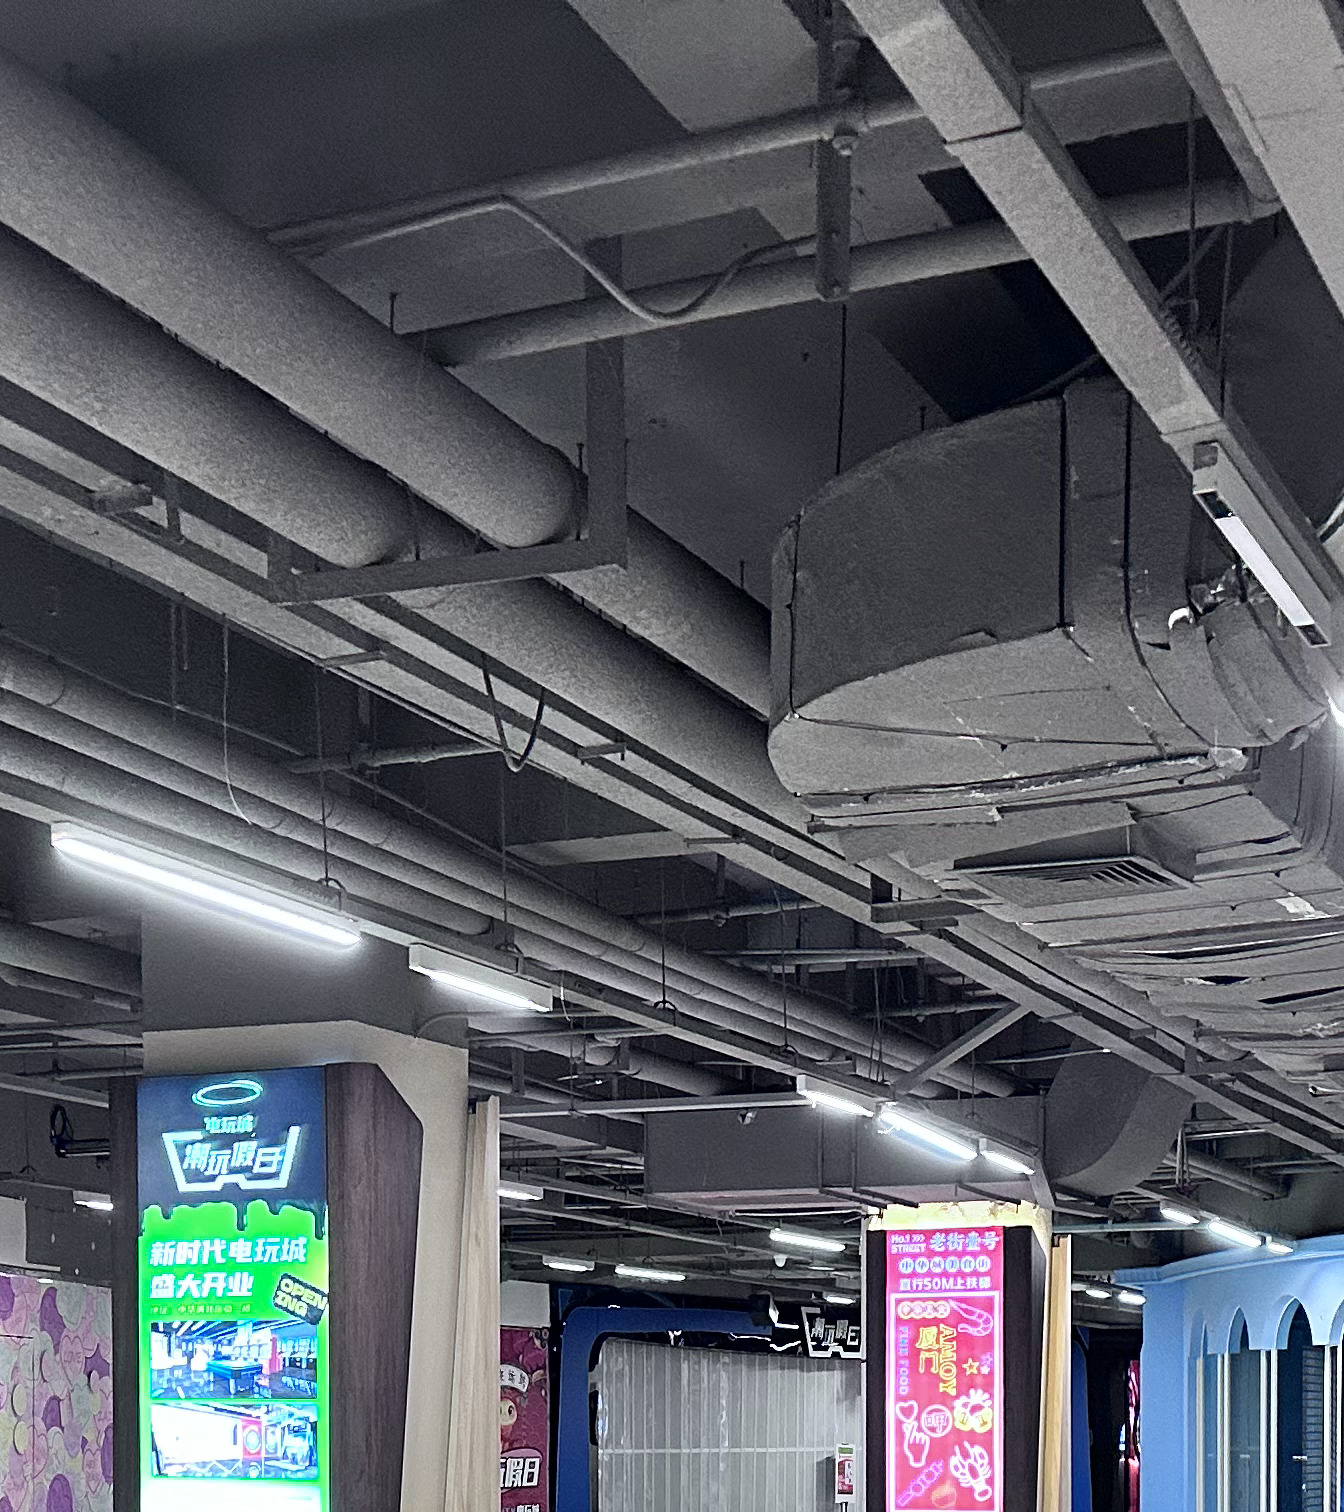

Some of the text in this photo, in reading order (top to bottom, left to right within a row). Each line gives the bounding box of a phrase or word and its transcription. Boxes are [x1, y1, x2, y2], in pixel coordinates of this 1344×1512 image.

[203, 1114, 255, 1134] 电玩城
[182, 1140, 284, 1176] 潮玩假日
[149, 1236, 308, 1267] 新时代电玩城
[929, 1230, 1000, 1253] 老街壹号
[149, 1271, 254, 1299] 盛大开业
[280, 1278, 328, 1311] OPEN
[274, 1290, 308, 1317] ING
[939, 1323, 957, 1397] AMOY
